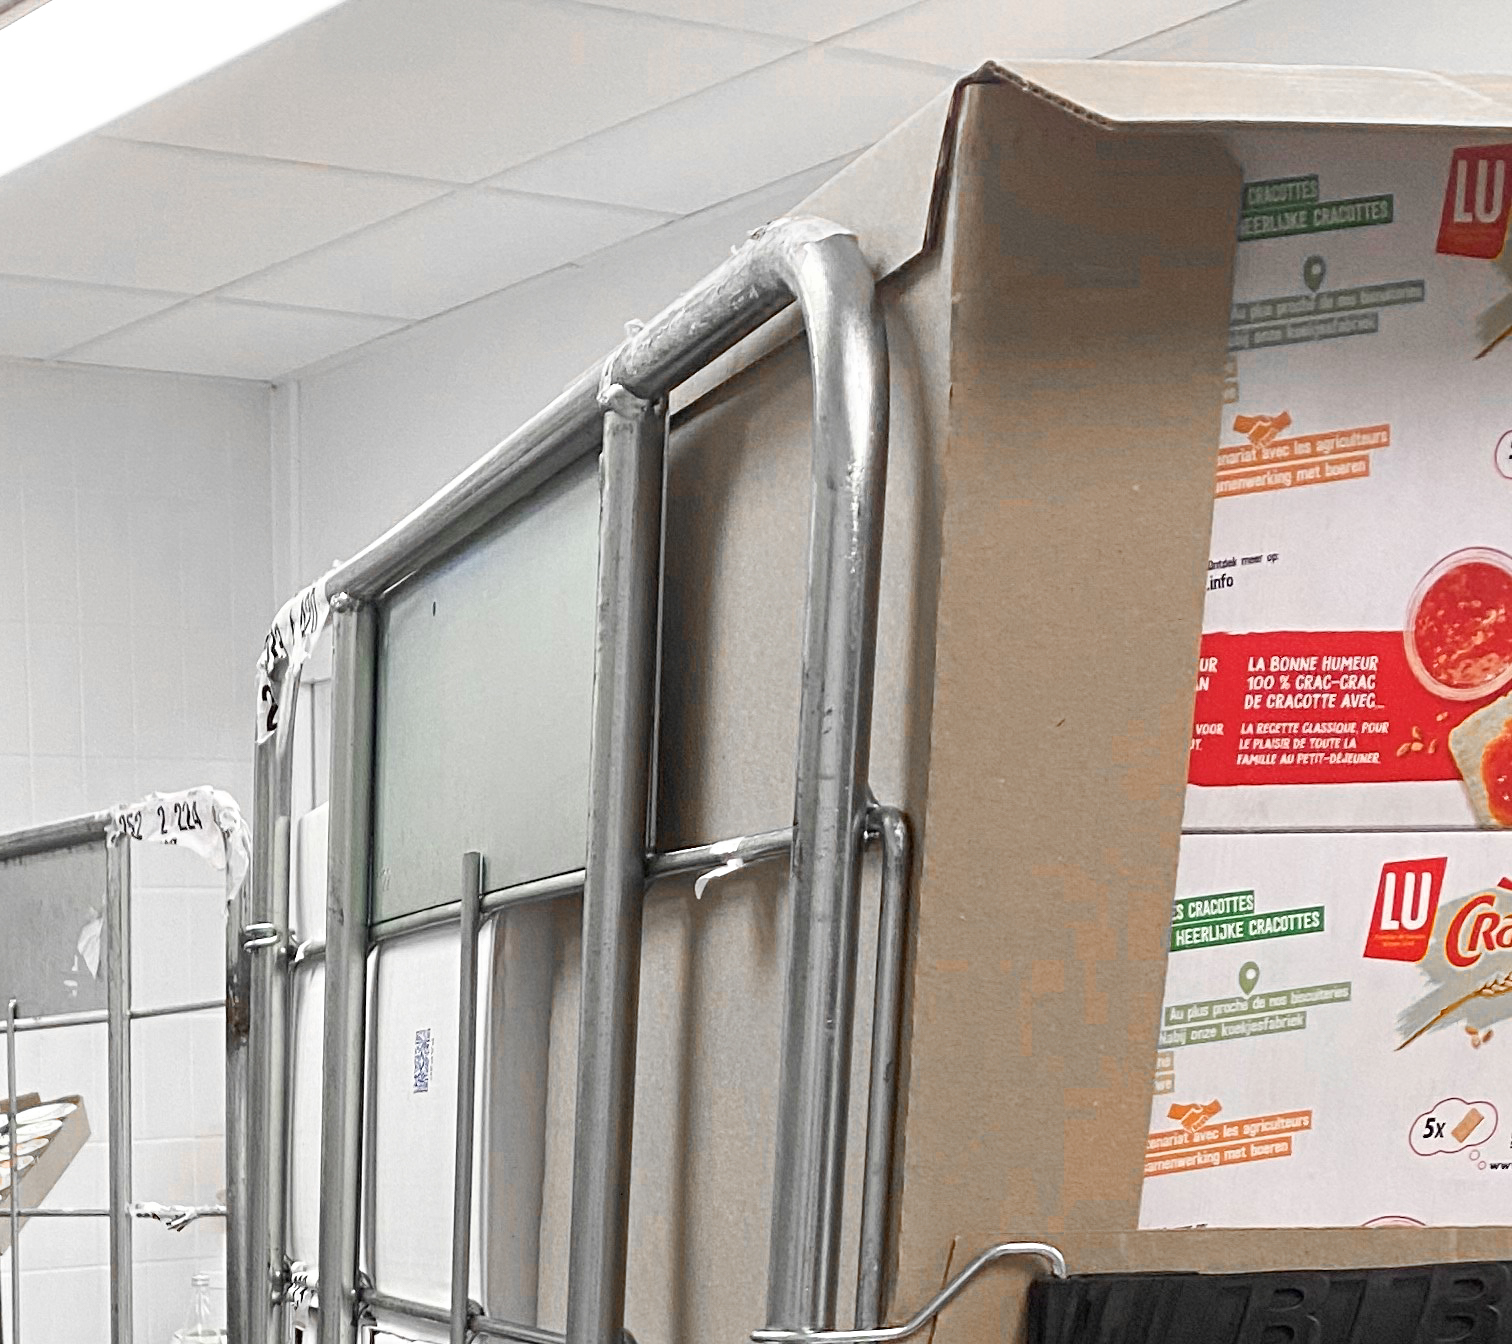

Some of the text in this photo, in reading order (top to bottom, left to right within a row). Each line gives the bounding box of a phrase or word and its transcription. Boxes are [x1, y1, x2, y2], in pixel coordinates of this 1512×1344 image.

[1454, 160, 1505, 223] LU
[1313, 200, 1389, 227] CRACOTTES
[1248, 655, 1379, 672] LA BONNE HUMEUR
[1247, 675, 1275, 691] 100
[1295, 674, 1376, 690] CRAC-CRAC
[1244, 693, 1337, 709] DE CRACOTTE
[1241, 723, 1254, 734] LA
[1256, 721, 1299, 734] RECETTE
[1362, 721, 1390, 734] POUR
[1239, 738, 1357, 750] LE PLAISIR DE TOUTE LA
[1237, 753, 1295, 765] FAMILLE AU
[1188, 894, 1254, 918] CRACOTTES
[1380, 871, 1433, 931] LU
[1176, 911, 1320, 947] HEERLIJKE CRACOTTES
[1243, 1113, 1311, 1138] agriculteurs
[1422, 1118, 1446, 1139] 5x
